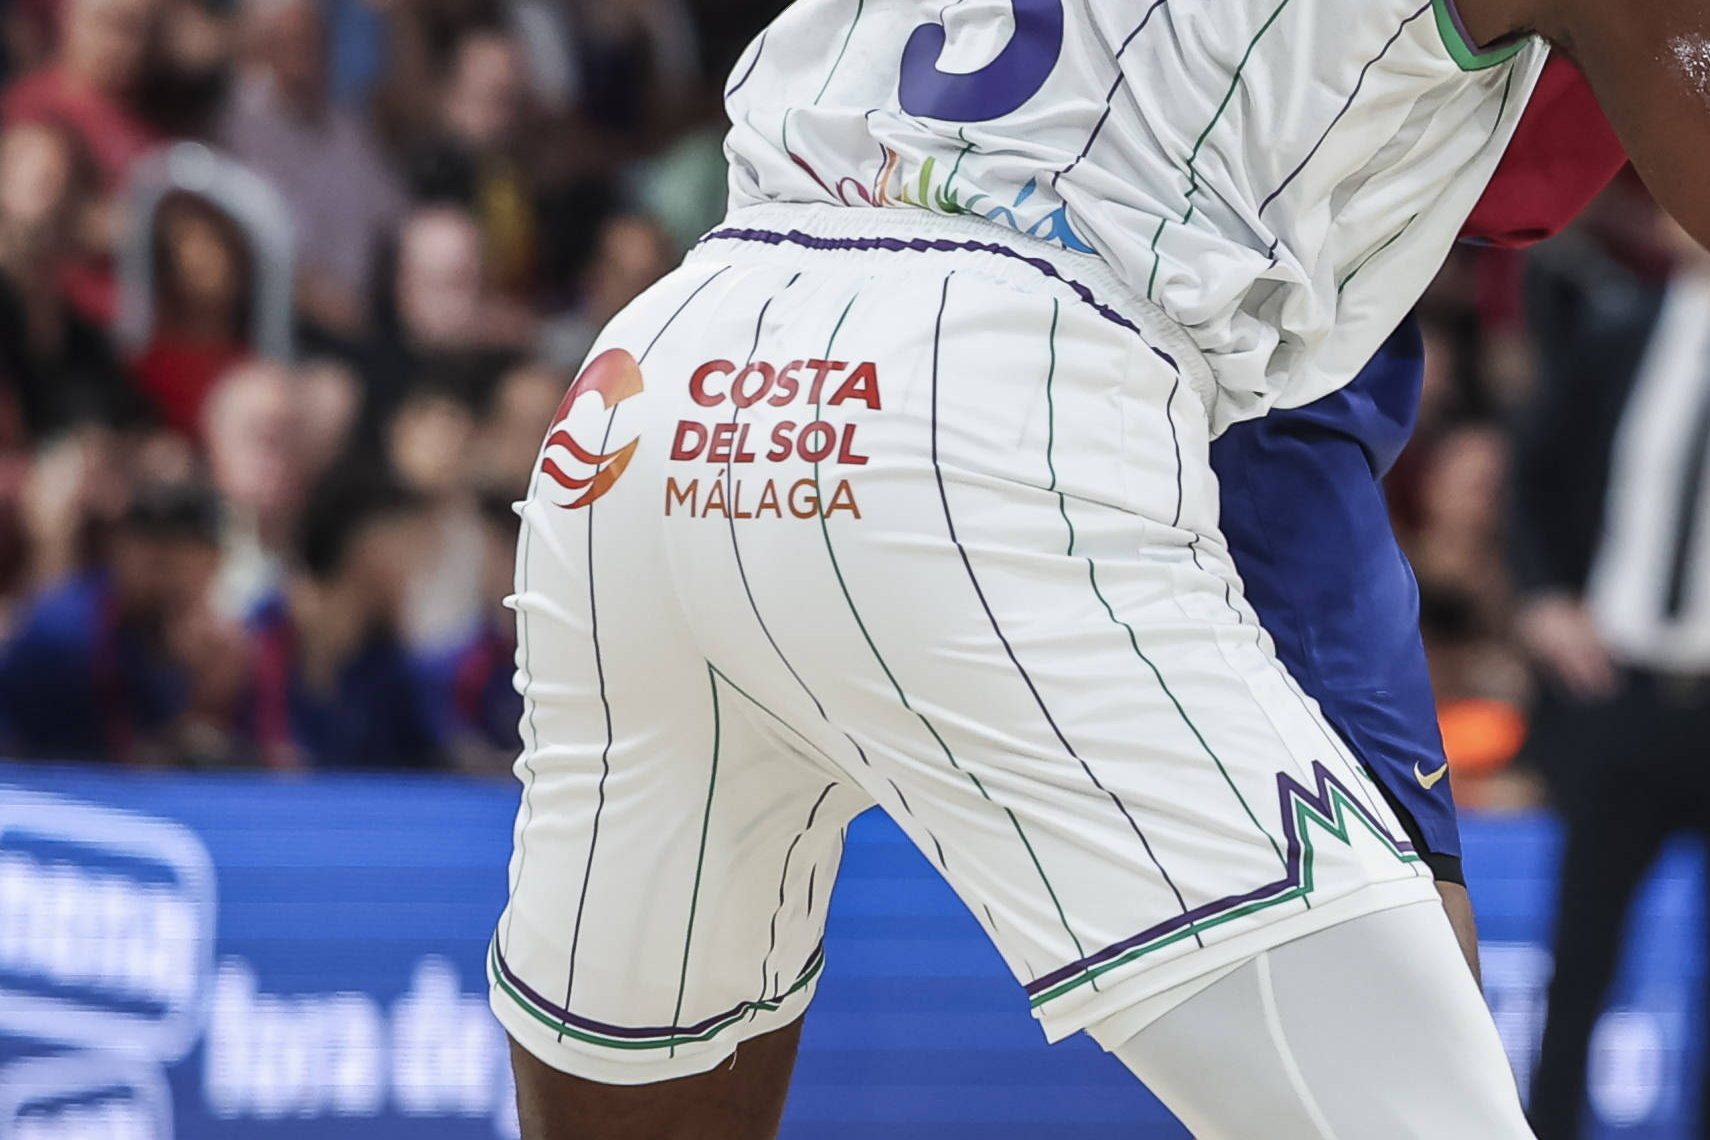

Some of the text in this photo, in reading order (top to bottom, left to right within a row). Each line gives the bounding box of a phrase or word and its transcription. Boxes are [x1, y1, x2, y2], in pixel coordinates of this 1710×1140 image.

[688, 358, 882, 411] COSTA
[669, 419, 870, 466] DEL SOL
[664, 468, 862, 520] MÁLAGA
